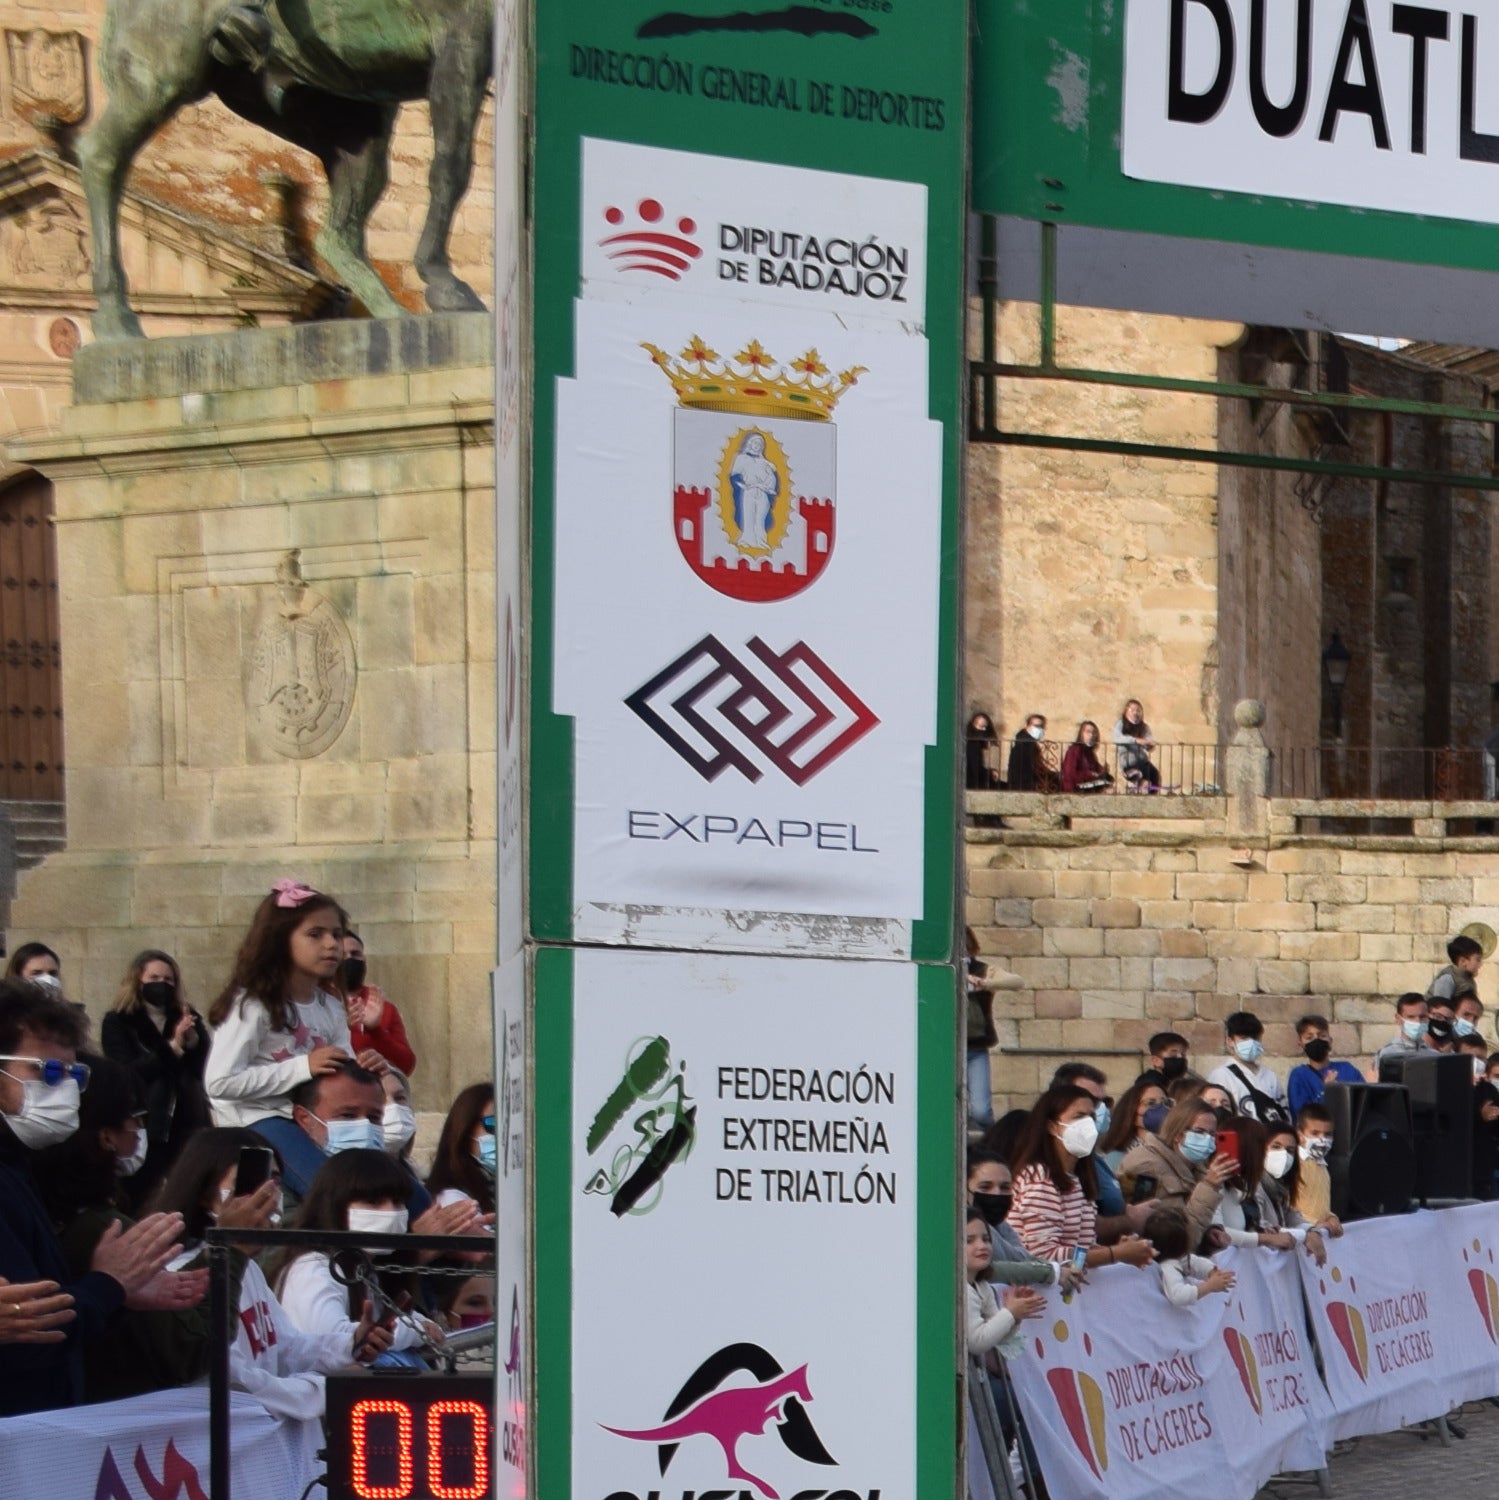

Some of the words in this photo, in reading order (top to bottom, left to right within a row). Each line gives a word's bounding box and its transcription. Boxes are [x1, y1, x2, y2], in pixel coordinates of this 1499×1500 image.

[569, 43, 694, 96] DIRECCIÓN
[701, 65, 801, 112] GENERAL
[808, 80, 835, 117] DE
[840, 85, 945, 131] DEPORTES
[719, 224, 908, 275] DIPUTACIÓN
[720, 259, 749, 283] DE
[758, 261, 908, 303] BADAJOZ
[627, 810, 880, 853] EXPAPEL
[717, 1063, 896, 1104] FEDERACIÓN
[723, 1117, 890, 1154] EXTREMEÑA
[716, 1168, 753, 1201] DE
[761, 1163, 897, 1204] TRIATLÓN
[1366, 1285, 1428, 1333] DIPUTACIÓN
[1106, 1348, 1204, 1410] DIPUTACIÓN
[1376, 1344, 1393, 1374] DE
[1119, 1423, 1144, 1463] DE
[1146, 1401, 1213, 1458] CÁCERES
